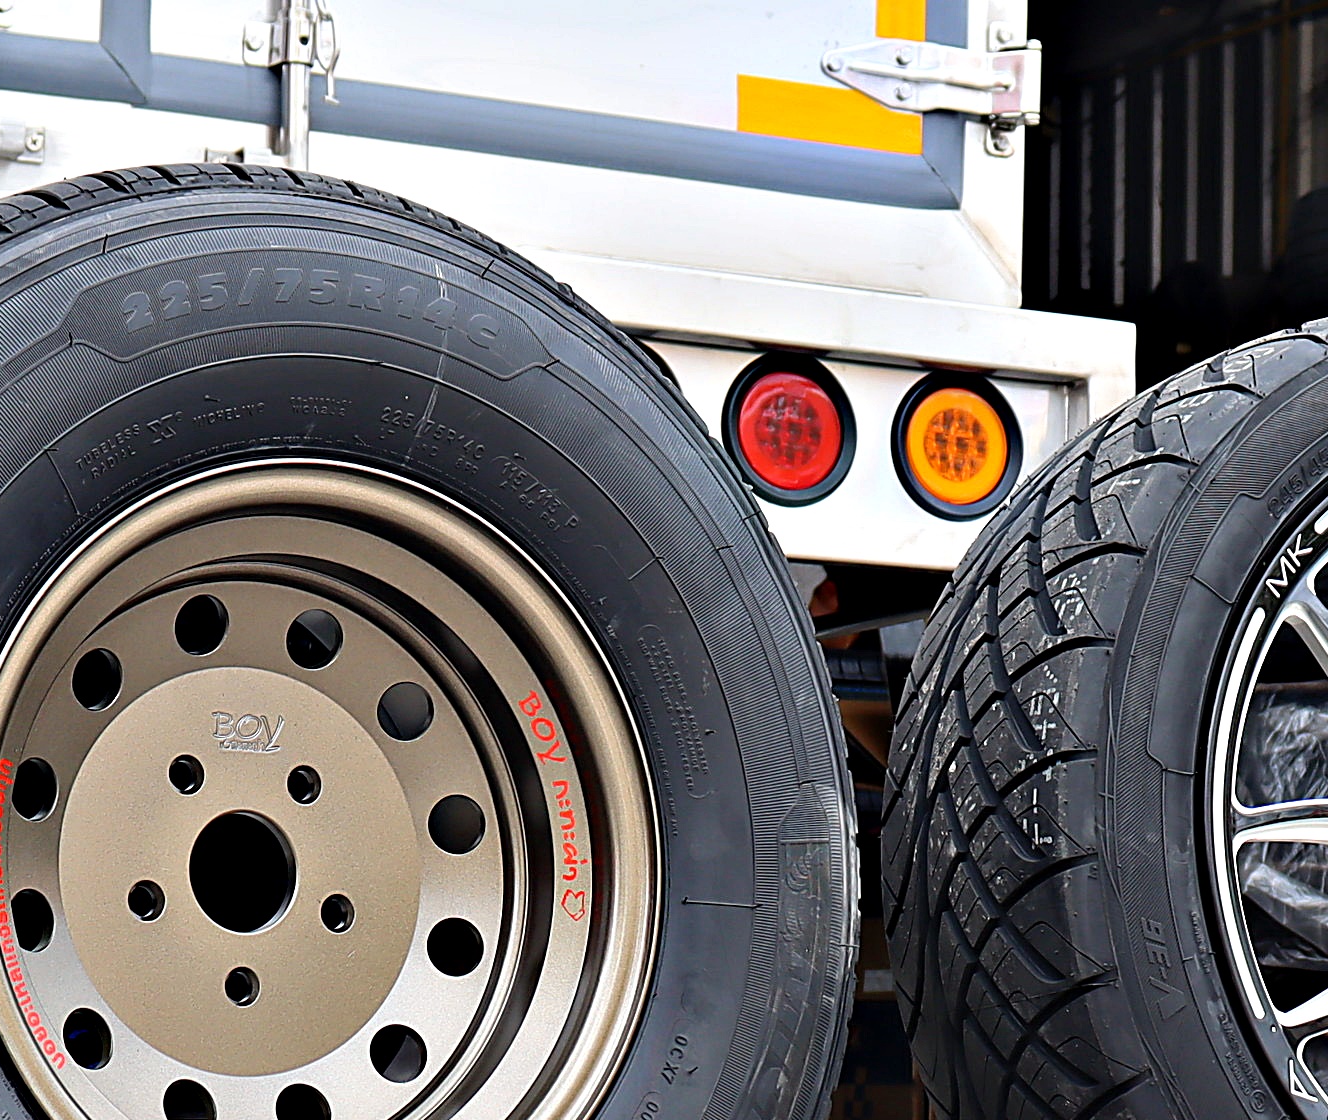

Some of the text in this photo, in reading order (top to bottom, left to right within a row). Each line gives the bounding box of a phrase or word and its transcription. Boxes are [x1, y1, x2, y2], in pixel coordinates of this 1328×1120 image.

[122, 267, 502, 351] 225/75R14C
[71, 417, 141, 470] TUBELESS
[1265, 533, 1314, 599] MK
[212, 711, 285, 752] BOY
[519, 690, 568, 765] BOY
